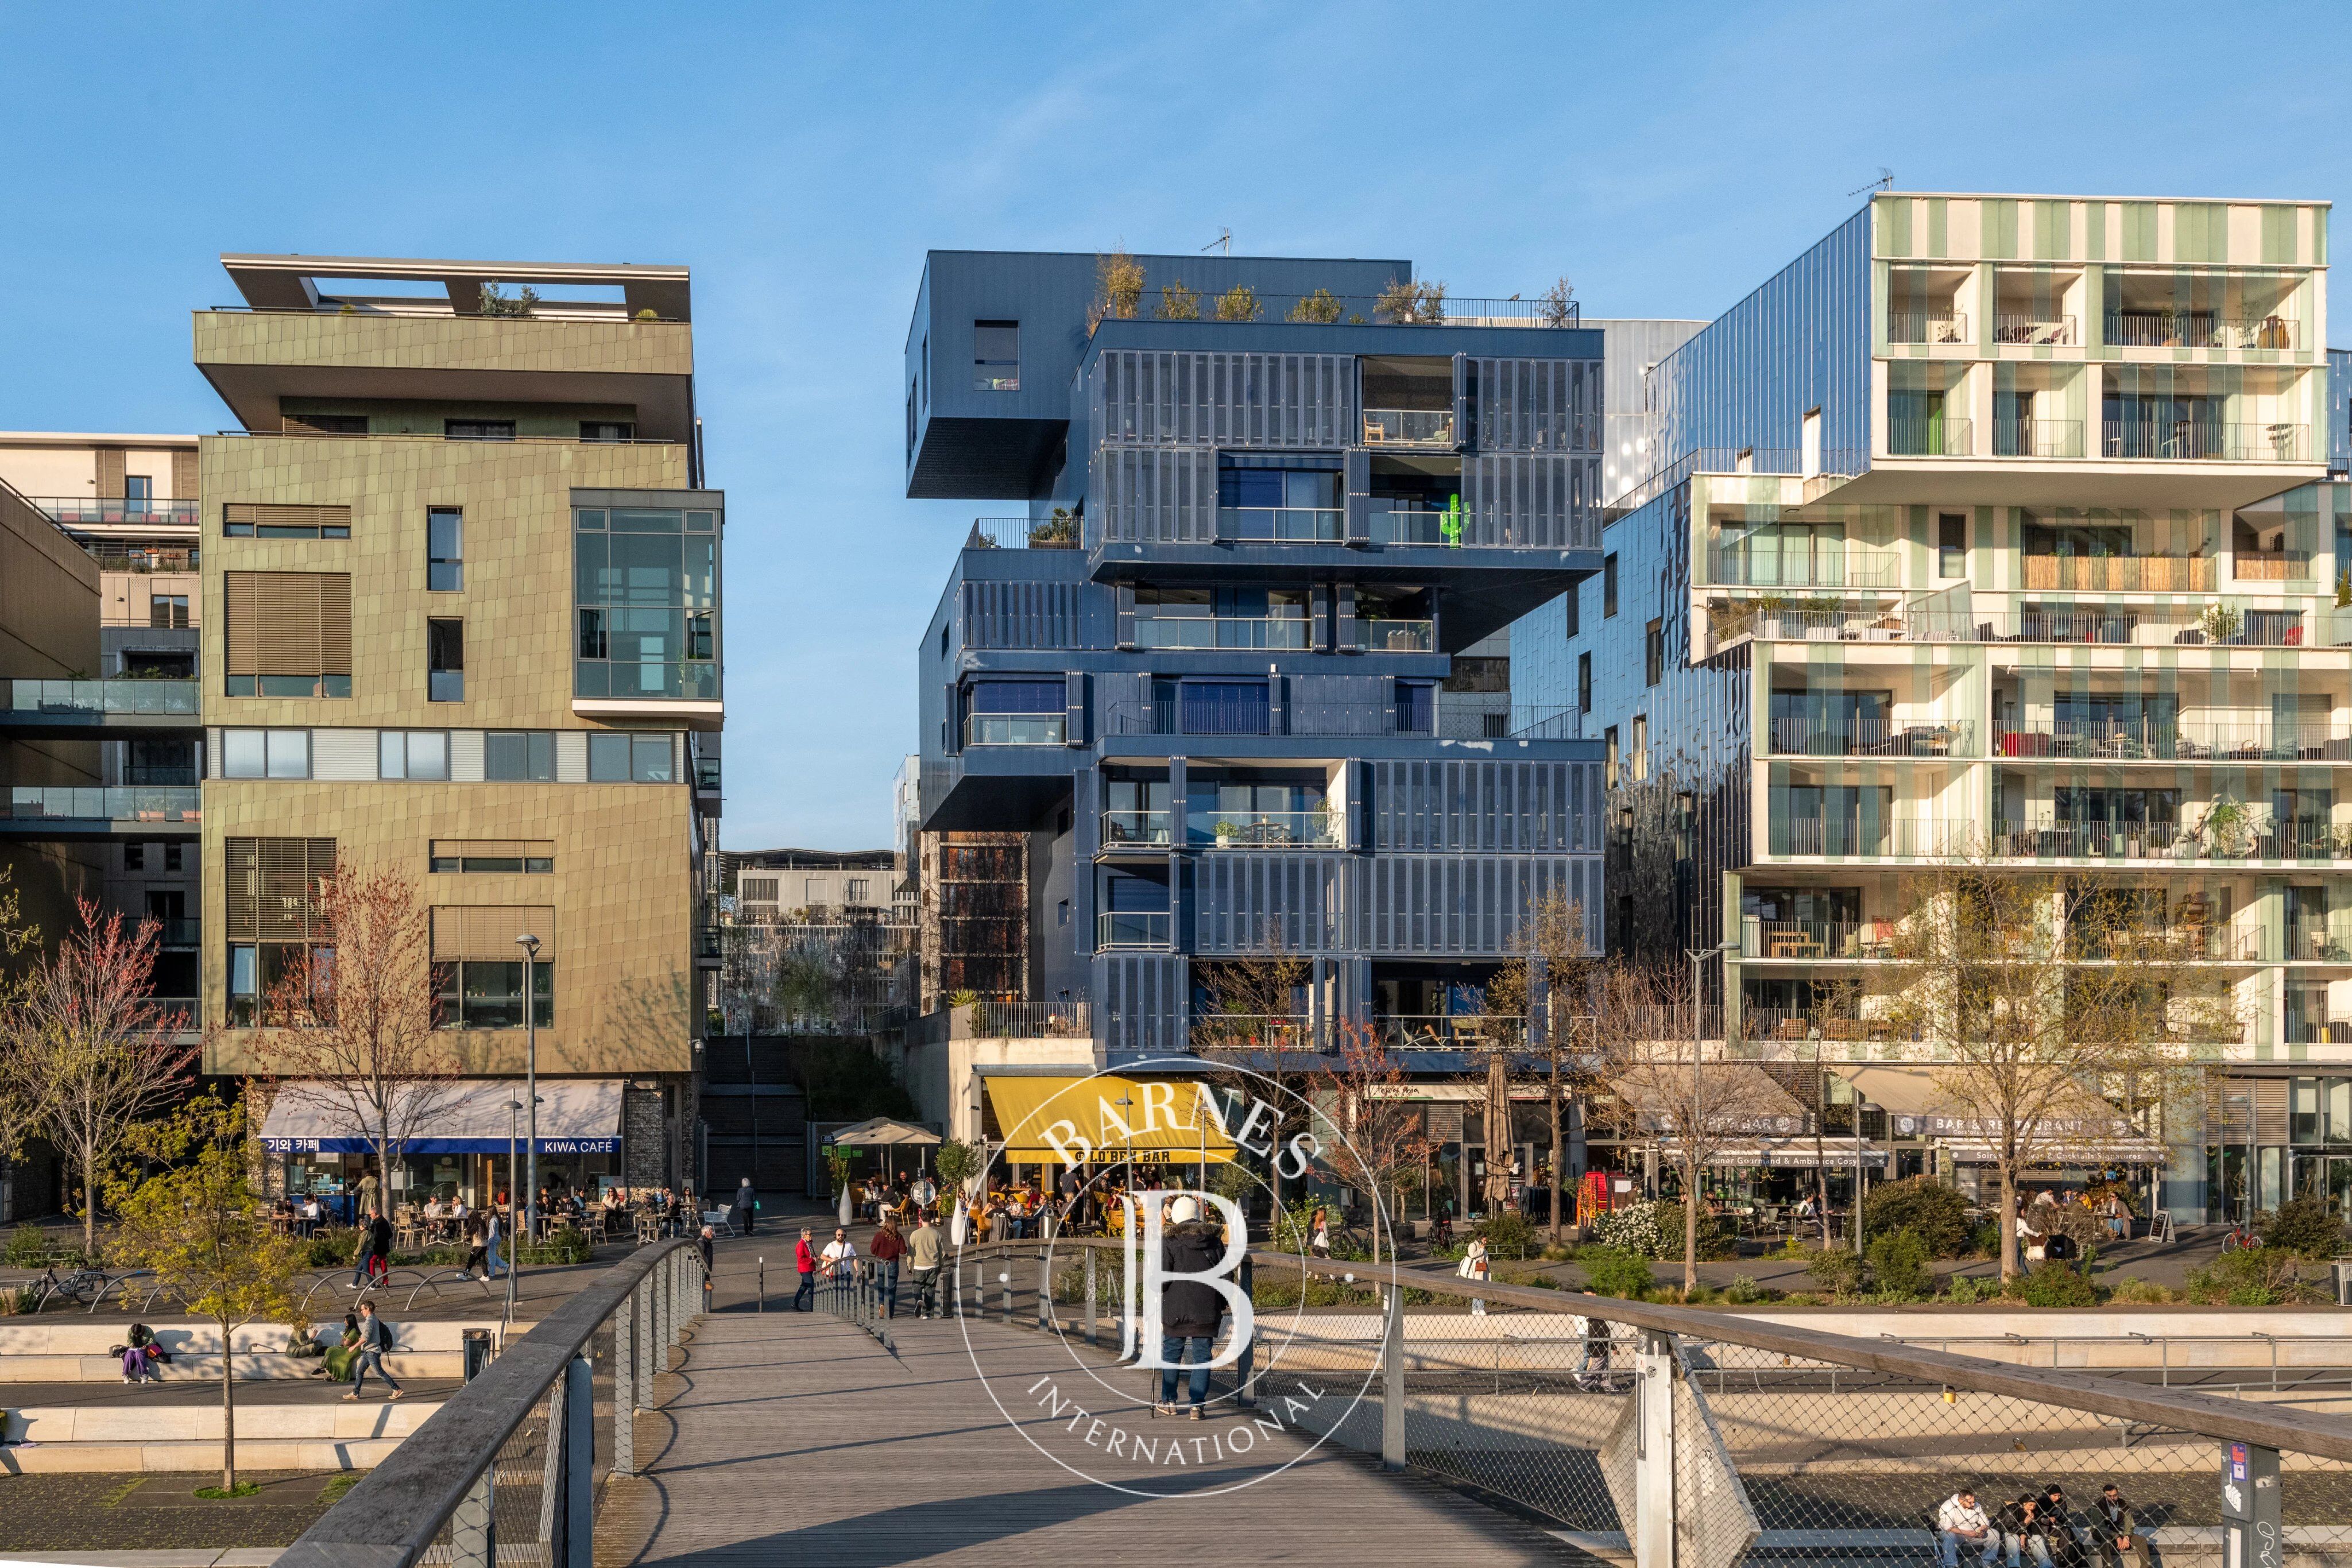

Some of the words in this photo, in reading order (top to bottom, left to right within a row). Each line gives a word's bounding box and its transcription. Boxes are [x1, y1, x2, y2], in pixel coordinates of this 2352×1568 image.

[1936, 1118, 1964, 1129] BAR
[1971, 1119, 1980, 1130] &
[1988, 1120, 2083, 1131] RETAURANT
[268, 1139, 292, 1152] 기와
[296, 1139, 319, 1152] 카페
[545, 1141, 577, 1152] KIWA
[580, 1139, 613, 1152] CAFÉ
[1143, 1151, 1171, 1162] BAR
[1838, 1157, 1857, 1166] Cosy
